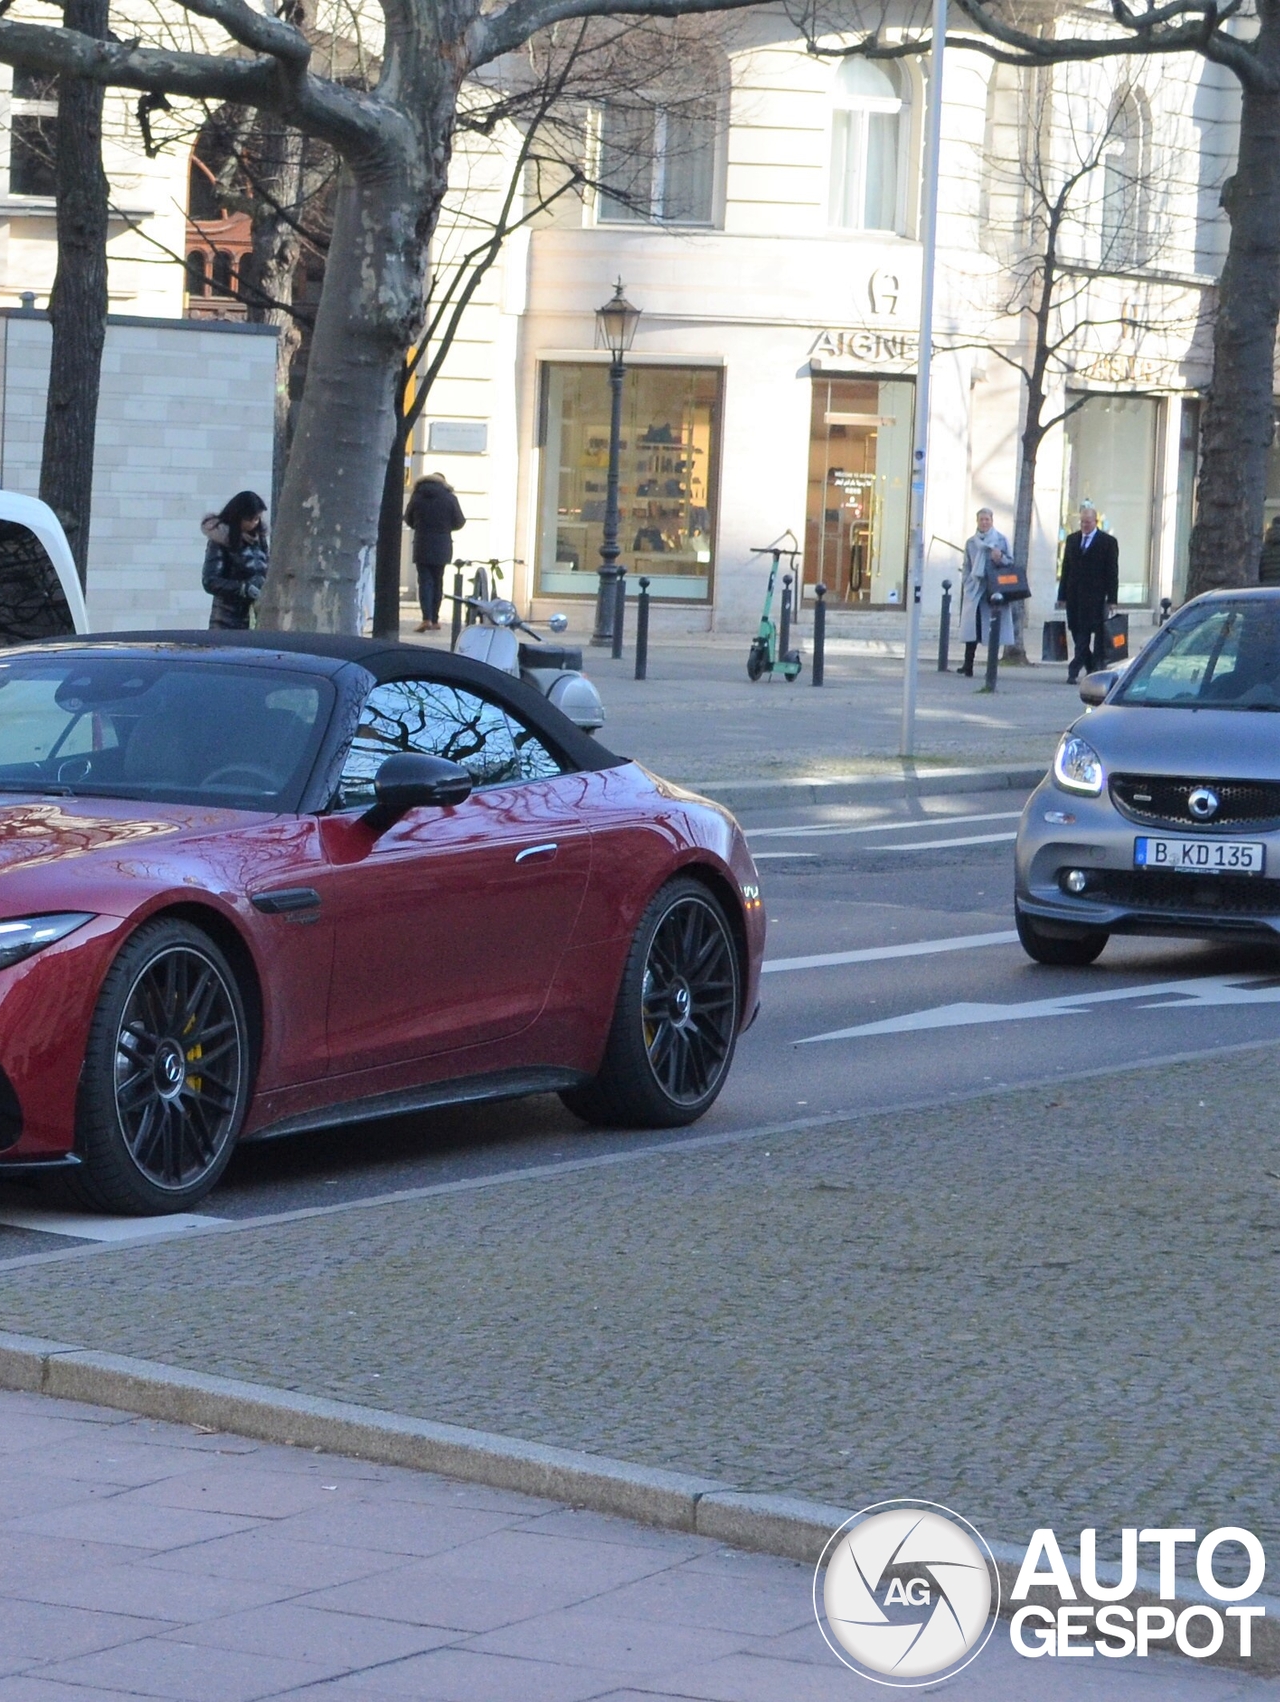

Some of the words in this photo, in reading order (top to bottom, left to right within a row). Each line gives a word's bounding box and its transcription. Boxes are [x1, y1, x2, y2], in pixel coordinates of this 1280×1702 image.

[806, 329, 935, 361] AIGNE
[1155, 842, 1168, 863] B
[1182, 844, 1210, 865] KD
[1214, 846, 1254, 868] 135
